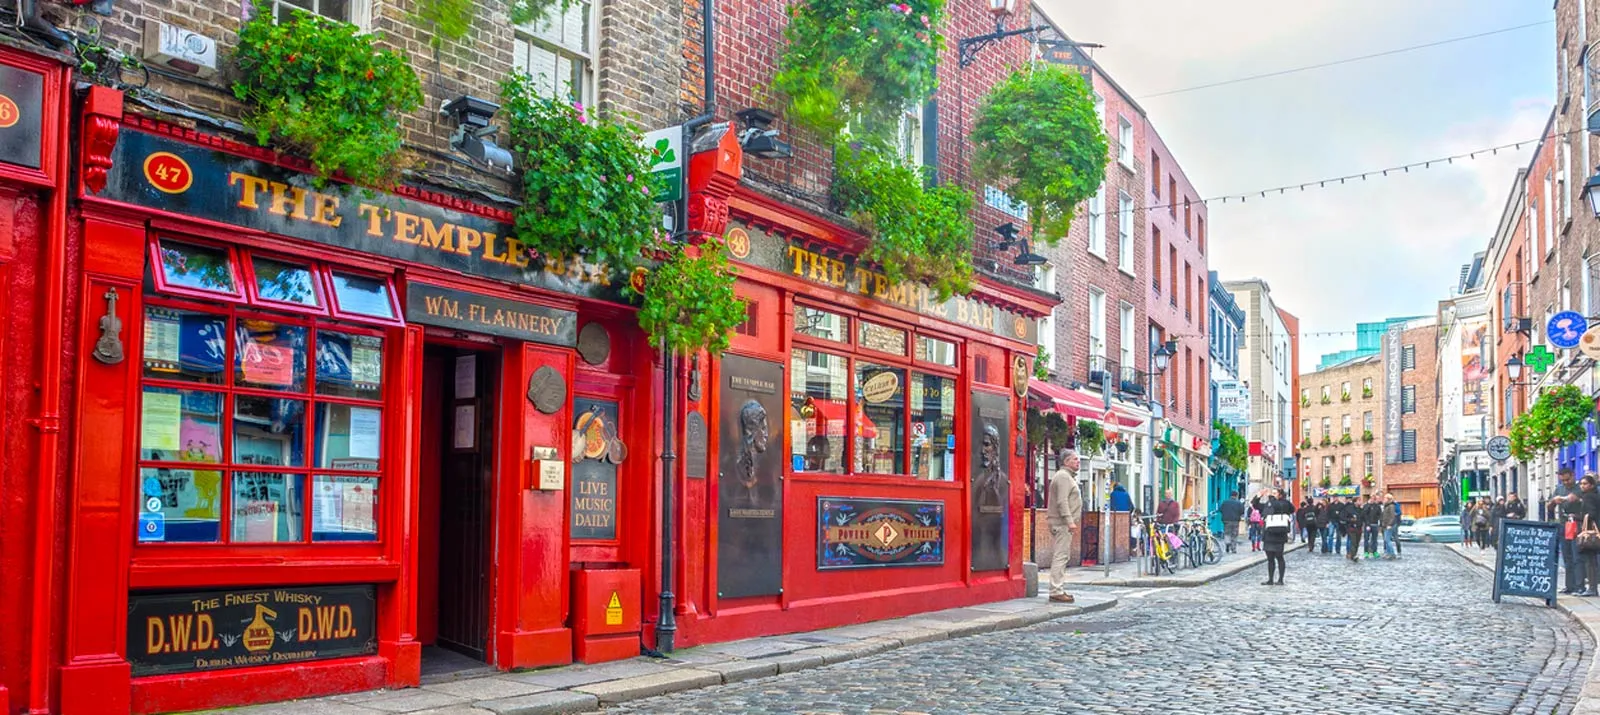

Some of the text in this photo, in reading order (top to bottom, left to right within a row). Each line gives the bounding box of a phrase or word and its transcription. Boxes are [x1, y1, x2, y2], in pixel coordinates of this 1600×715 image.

[154, 162, 181, 183] 47
[228, 171, 343, 228] THE
[358, 203, 530, 268] TEMPLE
[732, 233, 746, 254] 48
[787, 245, 846, 288] THE
[956, 296, 995, 333] BAR
[425, 295, 564, 336] WM. FLANNERY
[1389, 326, 1398, 431] NOW ENROLLING
[579, 481, 608, 495] LIVE
[575, 497, 612, 512] MUSIC
[575, 513, 611, 528] DAILY
[838, 525, 933, 544] POWERS P WHISKEY
[192, 590, 322, 612] THE FINEST WHISKY
[147, 604, 357, 654] D.W.D. D.W.D.
